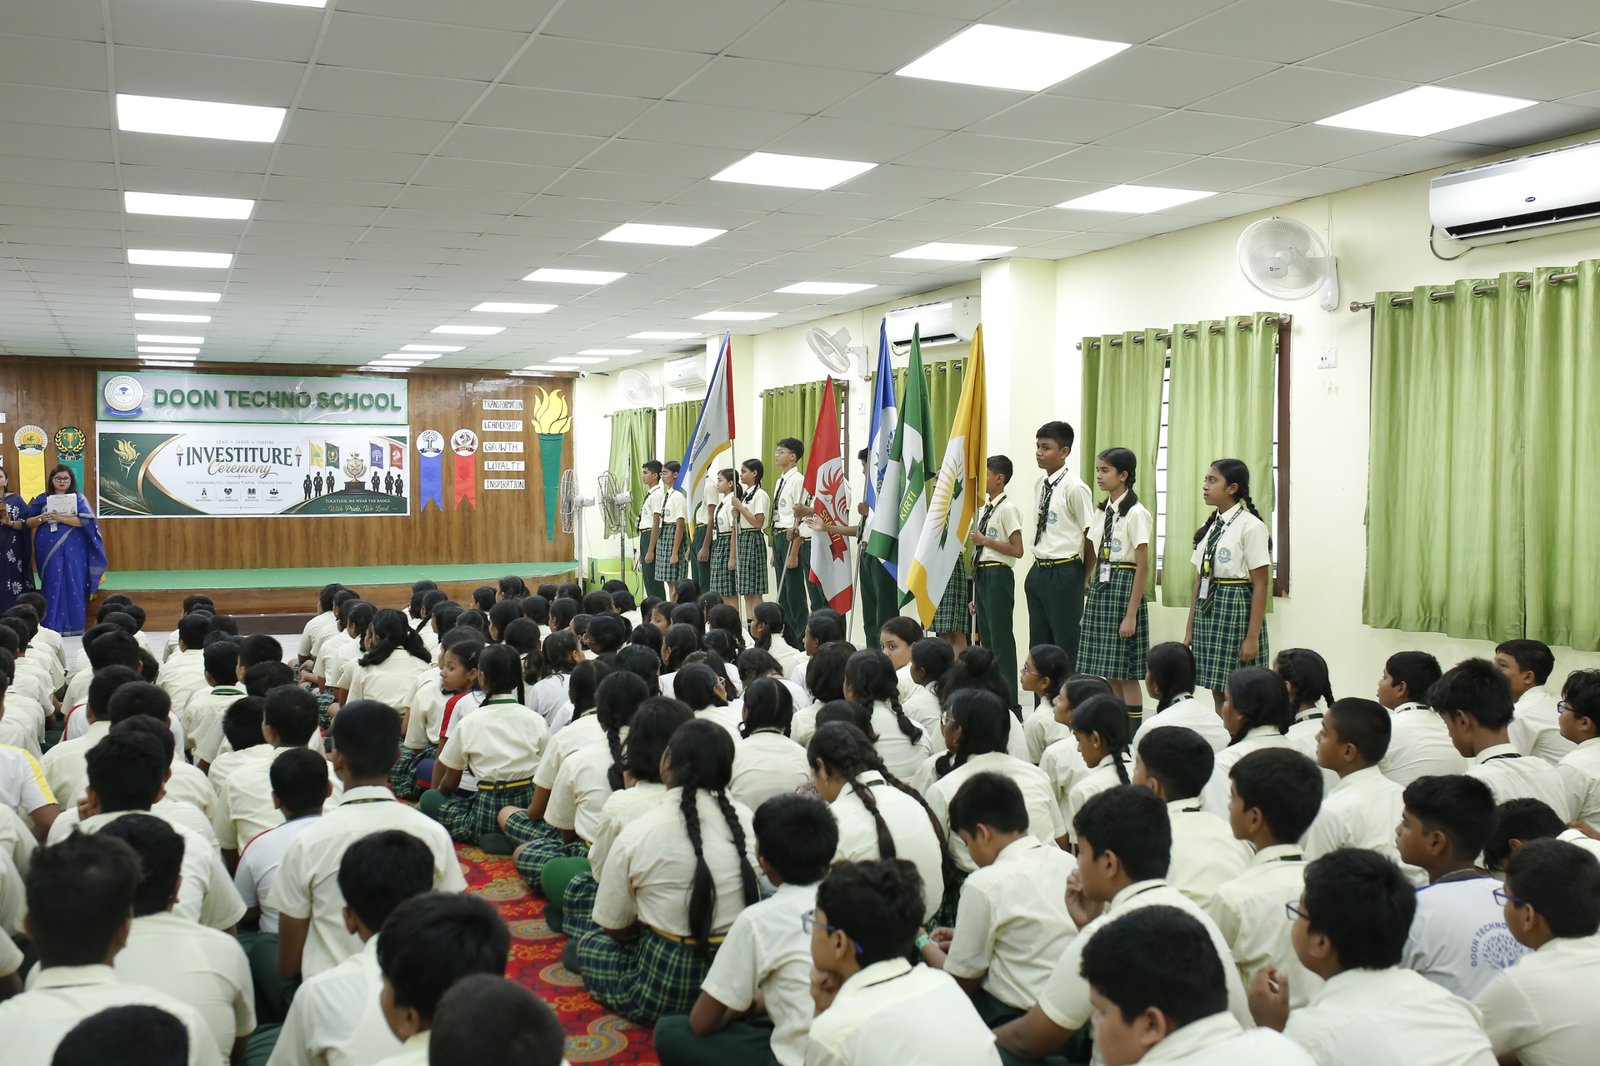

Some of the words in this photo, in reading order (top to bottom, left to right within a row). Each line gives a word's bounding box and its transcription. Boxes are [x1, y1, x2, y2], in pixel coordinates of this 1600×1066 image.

[154, 389, 218, 408] DOON
[224, 390, 312, 409] TECHNO
[316, 391, 402, 411] SCHOOL
[484, 400, 523, 409] TRANSFORMATION
[484, 421, 520, 430] LEADERSHIP
[484, 442, 518, 452] GROWTH
[186, 446, 293, 467] INVESTITURE
[487, 461, 521, 470] LOYALTY
[207, 459, 279, 479] Ceremony
[486, 480, 525, 489] INSPIRATION
[899, 490, 917, 521] KIRTI
[820, 509, 841, 542] SHATI
[1475, 921, 1508, 938] TECHNO
[1471, 938, 1480, 967] DOON
